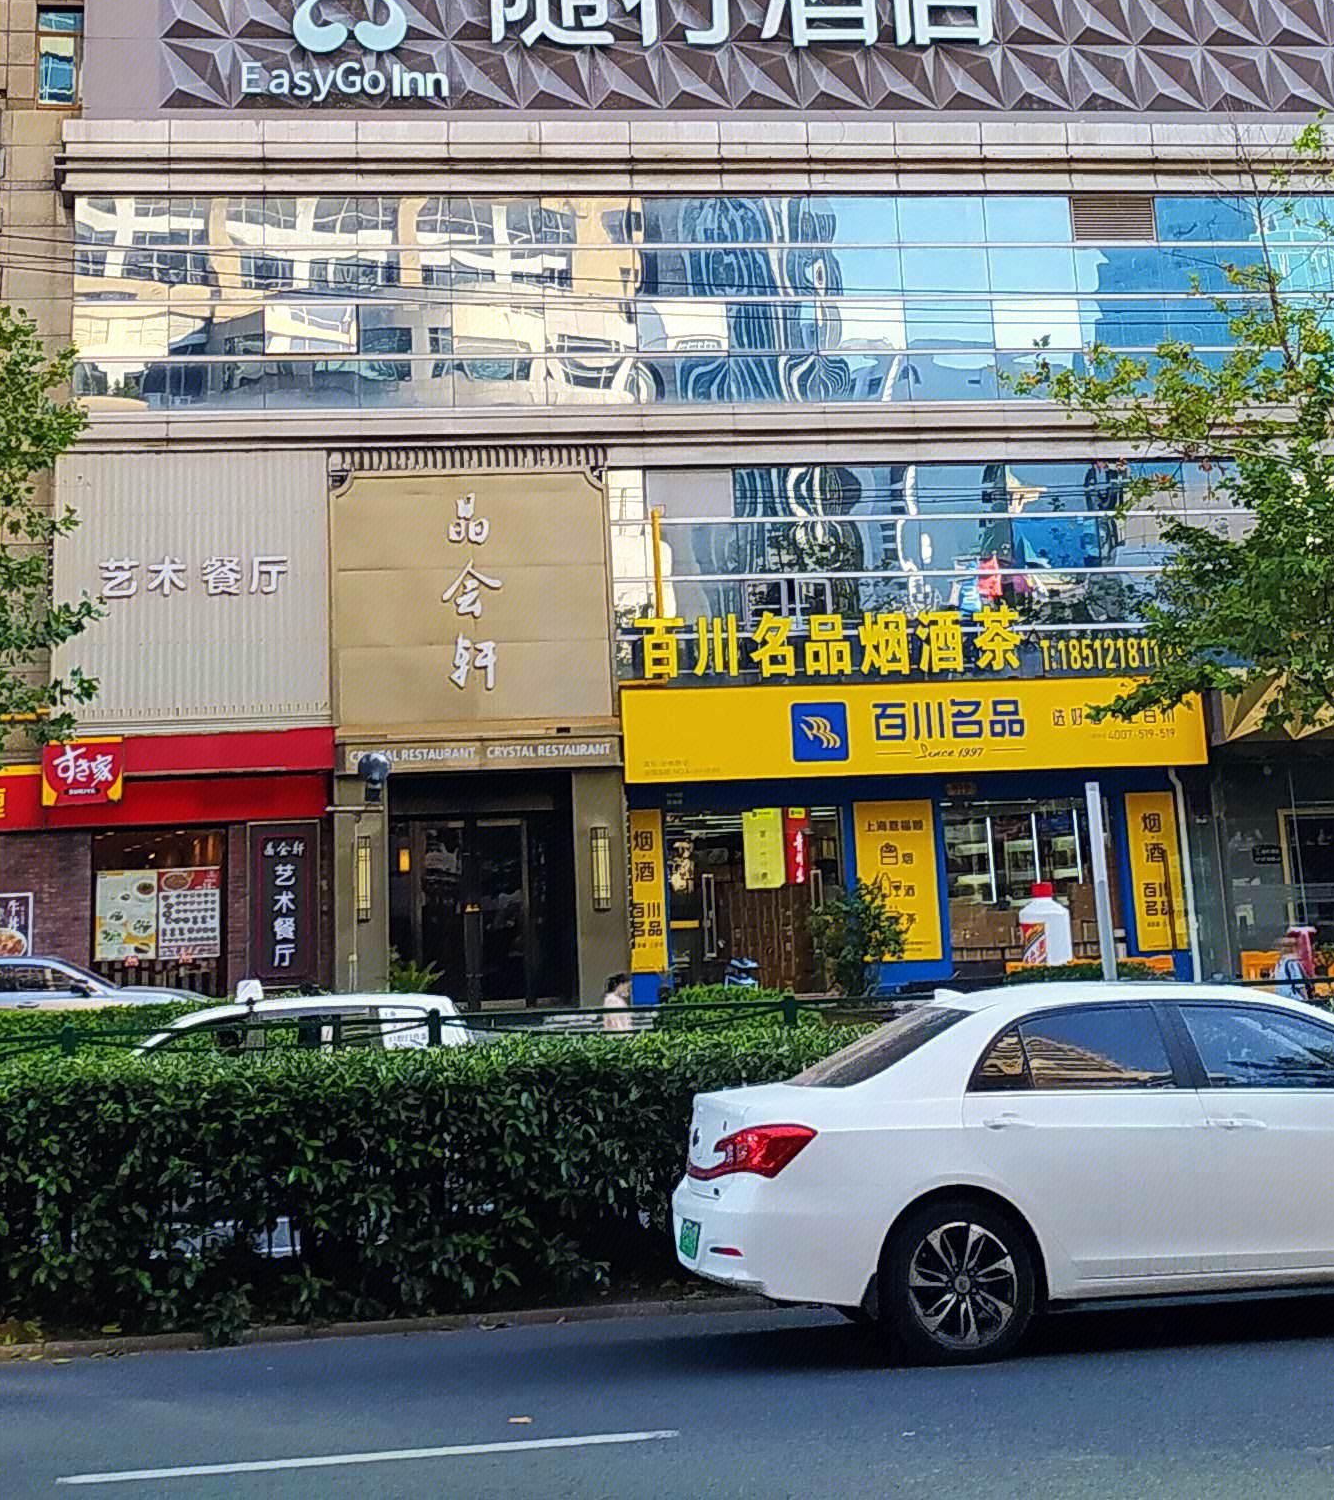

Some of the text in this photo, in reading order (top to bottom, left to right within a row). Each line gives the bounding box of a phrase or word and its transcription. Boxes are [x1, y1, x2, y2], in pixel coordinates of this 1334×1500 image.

[441, 491, 503, 692] 晶会轩
[633, 605, 1021, 679] 百川名品烟酒茶
[872, 698, 1025, 741] 百川名品
[401, 746, 476, 761] RESTAURANT
[486, 742, 612, 759] CRYSTAL RESTAURANT
[272, 862, 297, 967] 艺术餐厅
